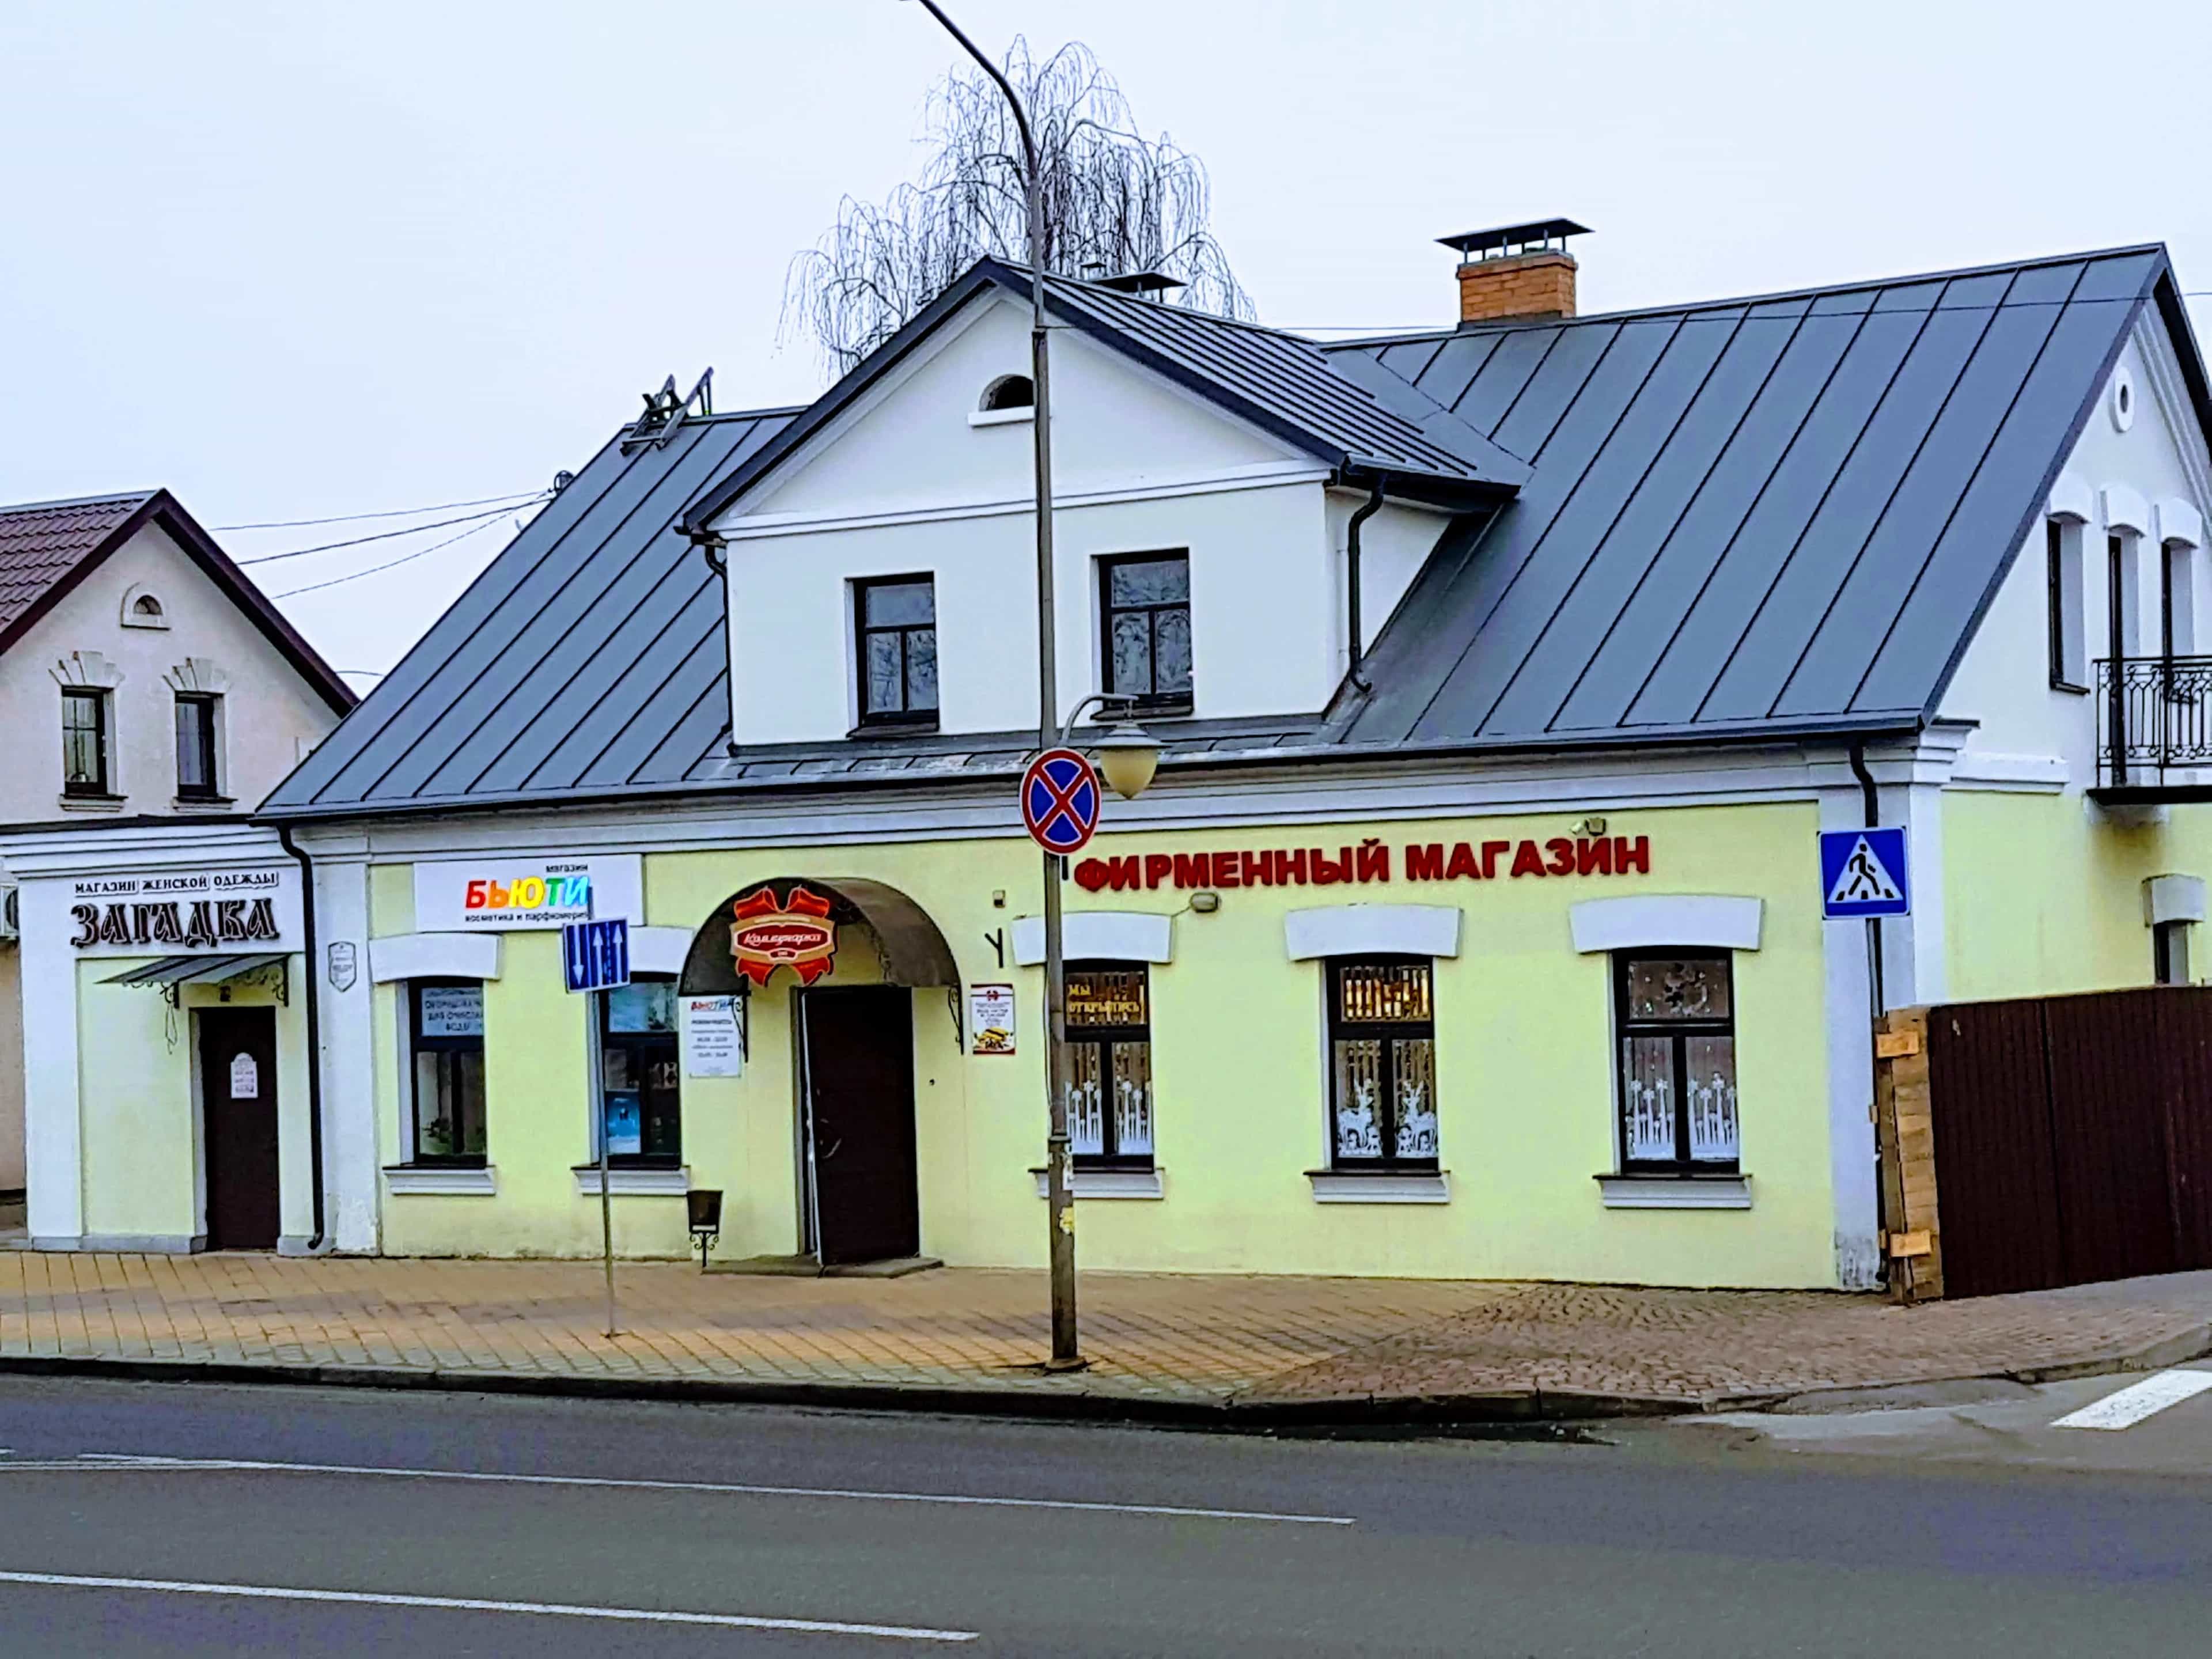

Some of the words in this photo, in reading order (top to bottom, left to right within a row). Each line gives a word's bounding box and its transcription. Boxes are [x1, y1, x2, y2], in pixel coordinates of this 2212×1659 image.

[1074, 838, 1389, 891] ФИРМЕННЫЙ
[1406, 835, 1649, 881] МАГАЗИН
[75, 881, 136, 893] МАГАЗИН
[143, 876, 207, 890] ЖЕНСКОЙ
[214, 873, 275, 886] ОДЕЖДЫ
[465, 876, 588, 908] БЬЮТИ
[70, 898, 279, 948] ЗАГАДКА
[465, 914, 513, 922] косметика
